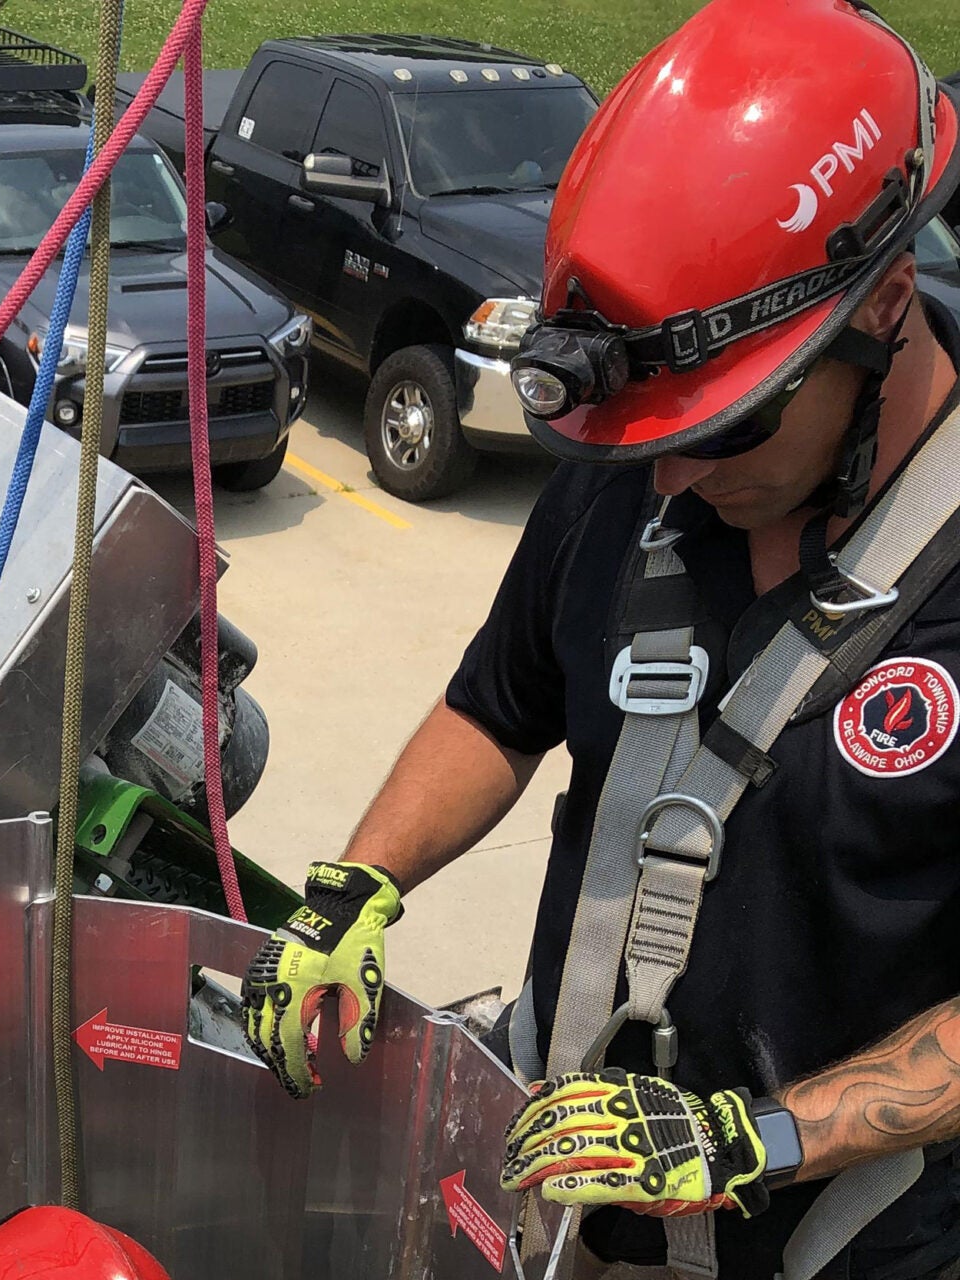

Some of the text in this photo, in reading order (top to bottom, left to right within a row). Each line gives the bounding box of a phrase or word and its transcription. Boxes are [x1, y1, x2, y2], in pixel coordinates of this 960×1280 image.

[810, 107, 882, 198] PMI
[801, 609, 837, 641] PMI
[854, 666, 949, 735] CONCORD TOWNSHIP
[843, 719, 925, 769] DELAWARE OHIO
[870, 728, 898, 748] FIRE
[92, 1024, 125, 1035] IMPROVE
[96, 1040, 137, 1051] LUBRICANT
[150, 1048, 173, 1058] HINGE
[106, 1034, 164, 1048] APPLY SILICONE
[89, 1046, 119, 1056] BEFORE
[120, 1051, 136, 1059] AND
[136, 1054, 160, 1063] AFTER
